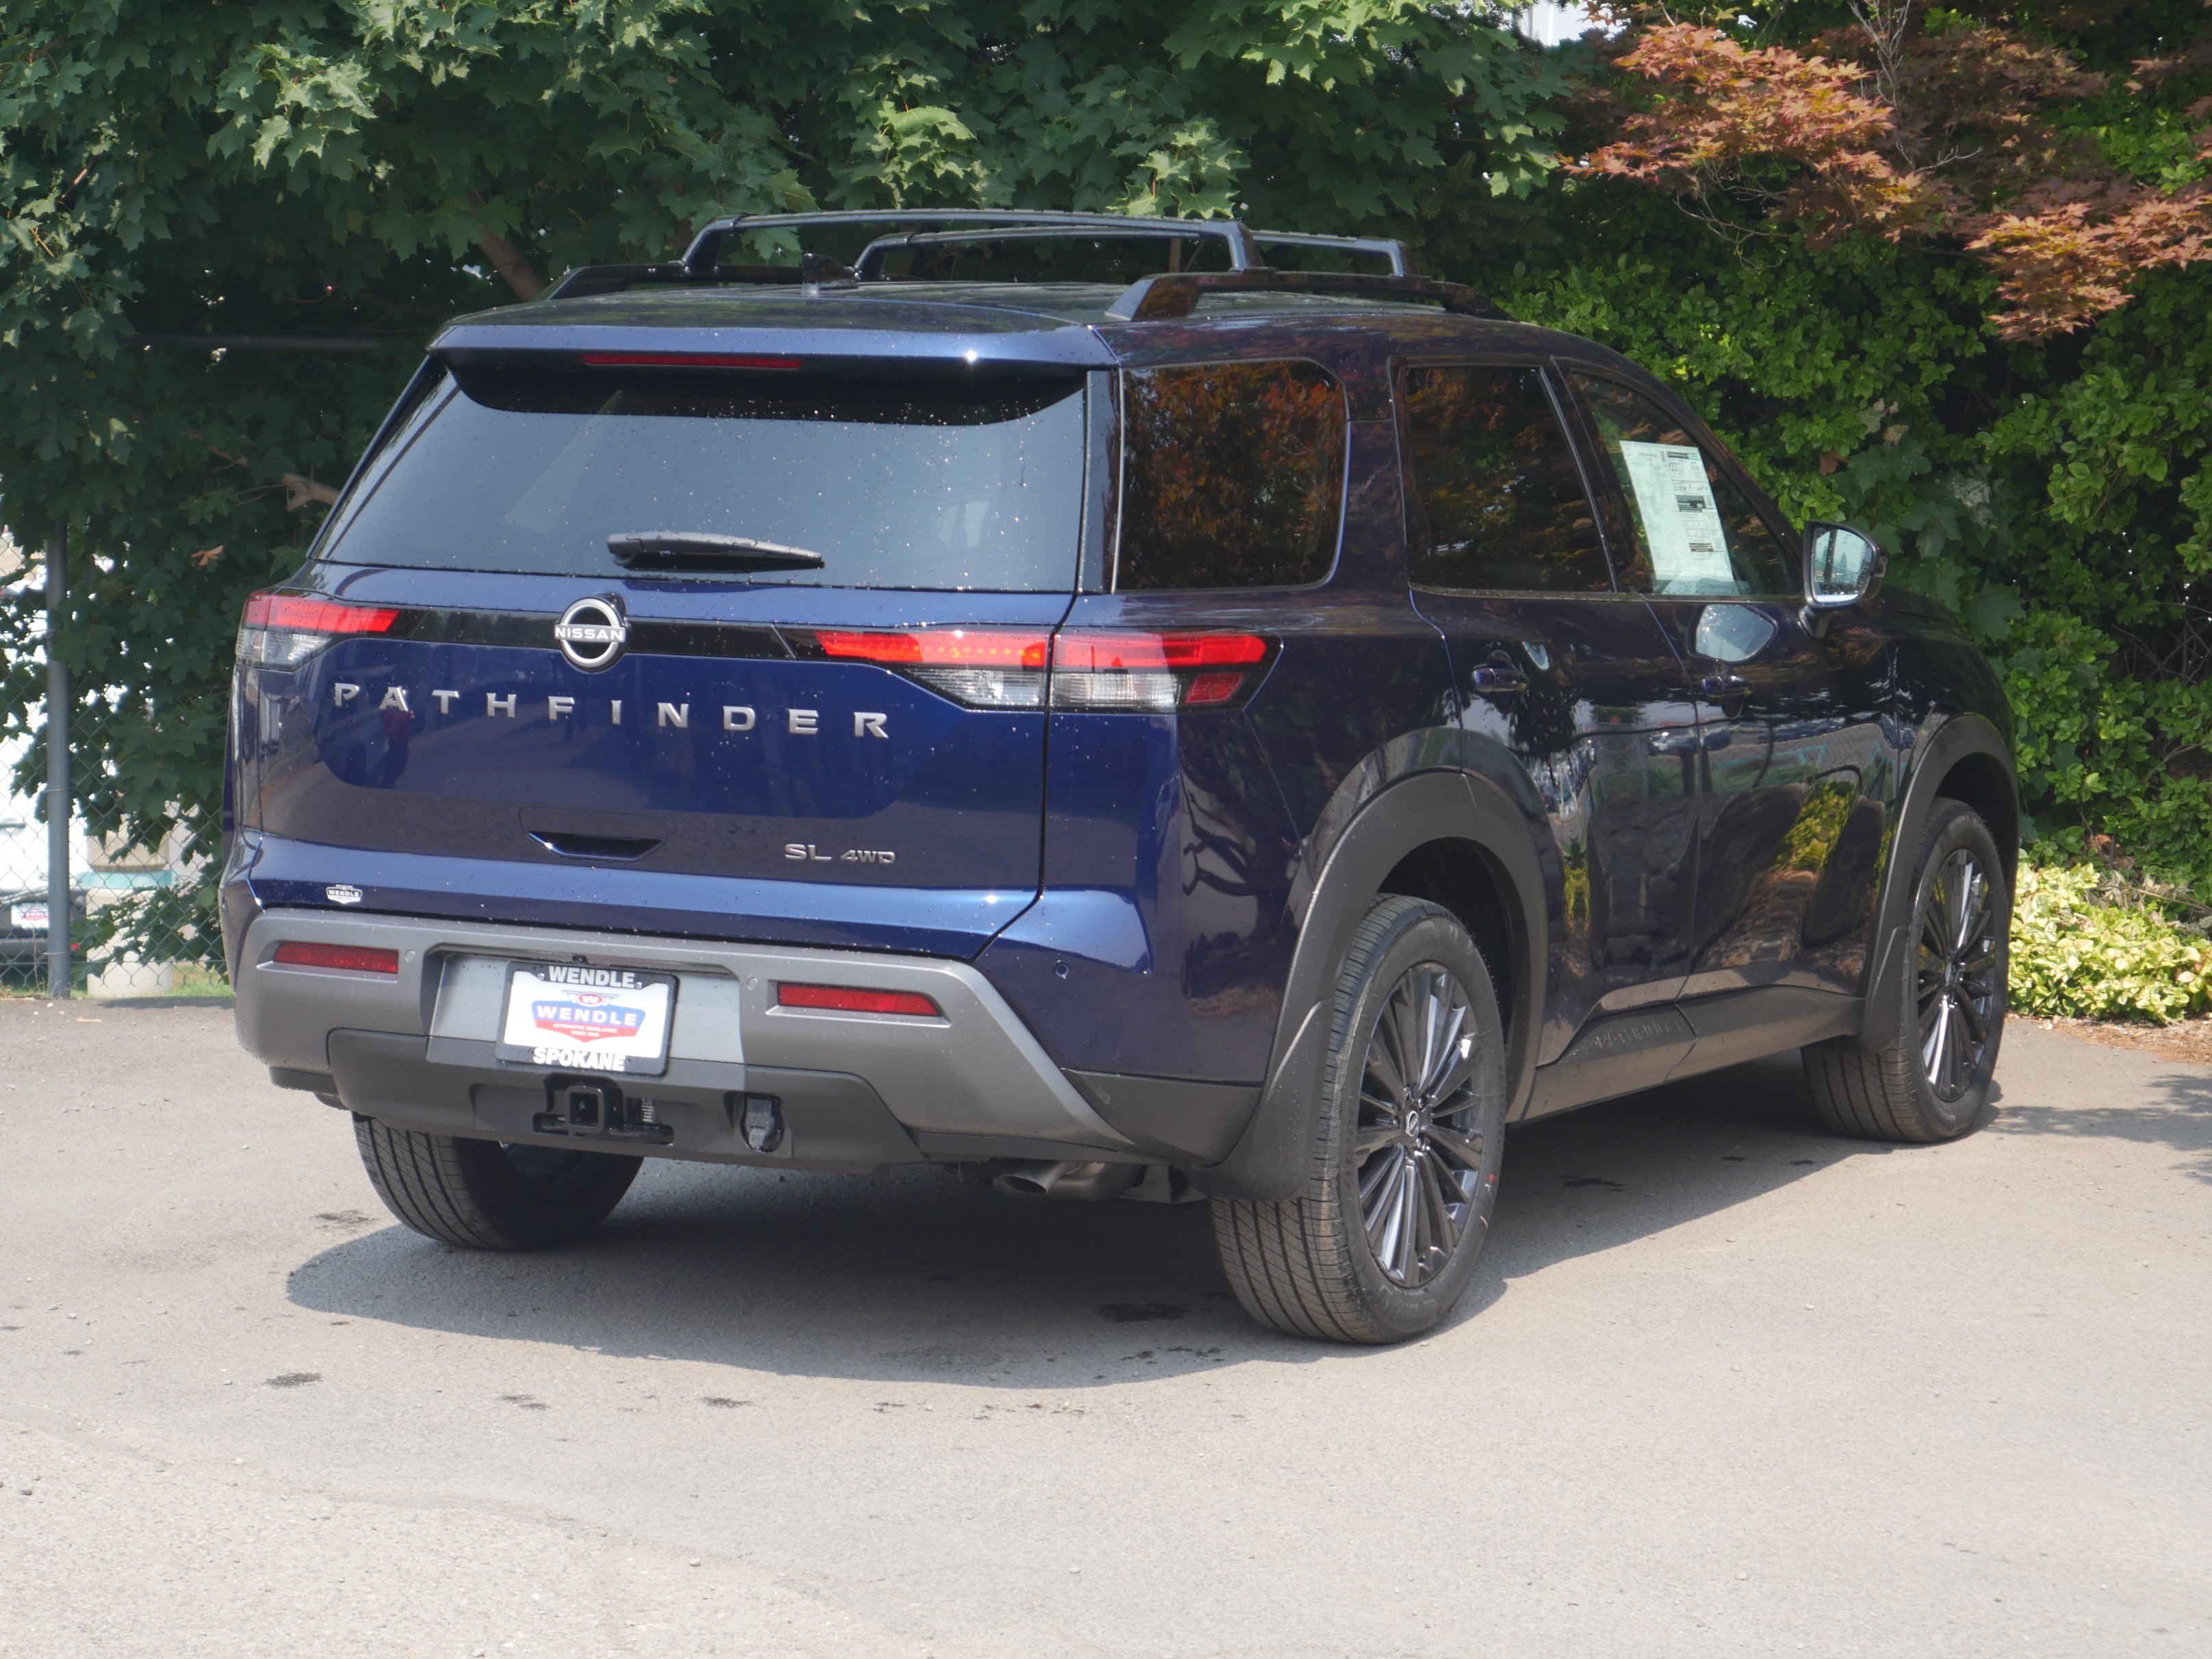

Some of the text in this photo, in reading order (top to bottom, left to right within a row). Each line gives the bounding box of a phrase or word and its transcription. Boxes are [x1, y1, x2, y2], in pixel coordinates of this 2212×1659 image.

[554, 627, 626, 642] NISSAN
[333, 683, 889, 739] PATHFINDER
[784, 843, 896, 864] SL 4WD
[329, 889, 359, 897] WENDLE
[549, 966, 635, 988] WENDLE
[537, 1005, 637, 1026] WENDLE
[533, 1047, 626, 1071] SPOKANE
